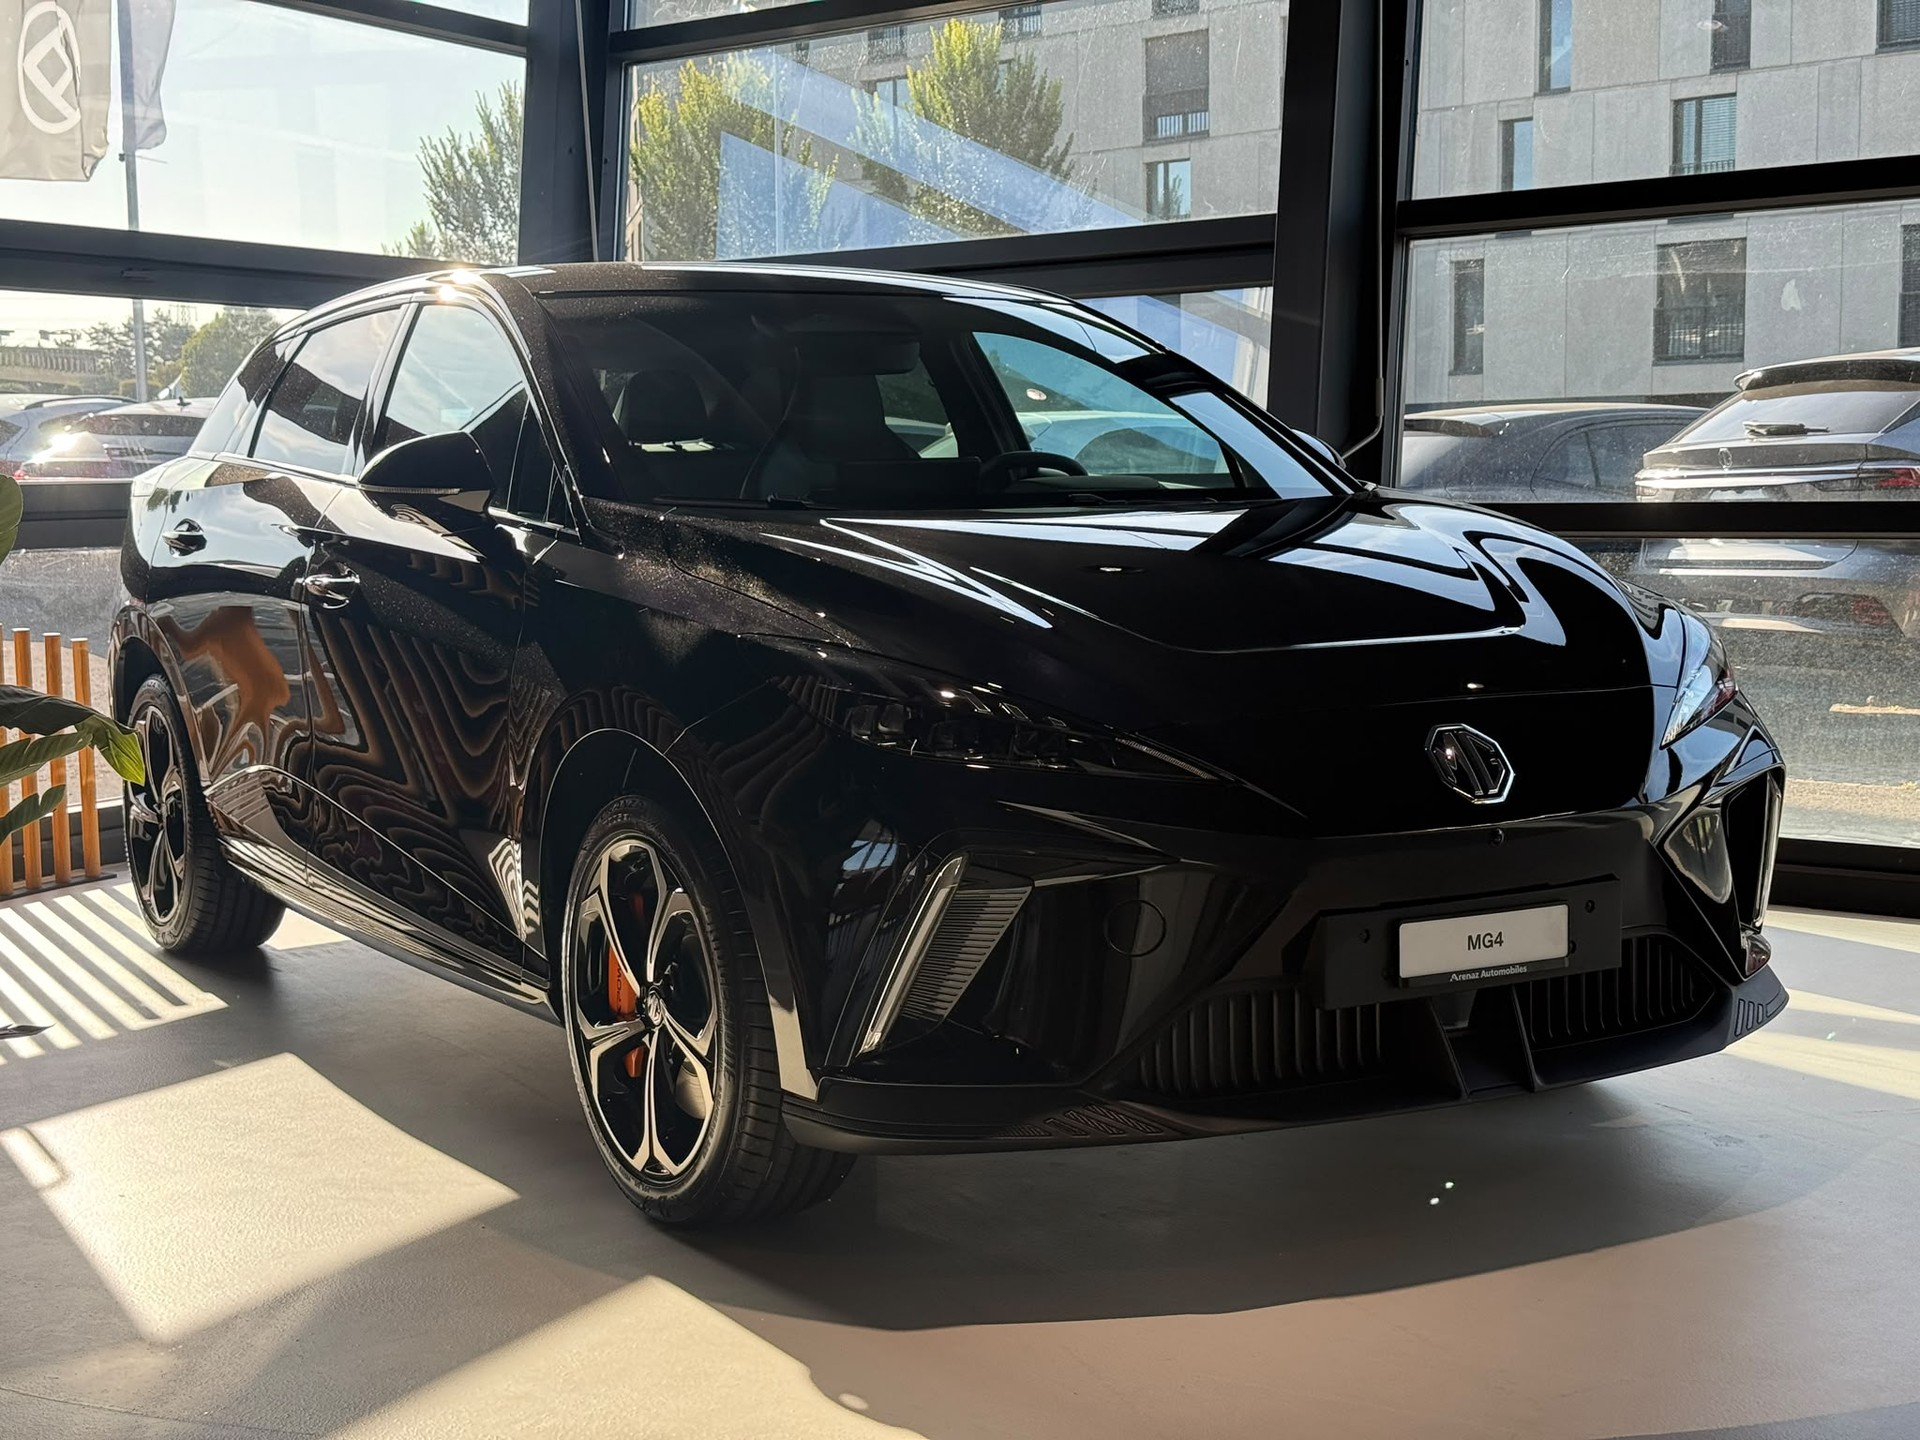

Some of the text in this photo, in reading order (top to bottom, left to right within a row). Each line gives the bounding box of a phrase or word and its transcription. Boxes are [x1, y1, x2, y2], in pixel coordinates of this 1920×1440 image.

[1434, 731, 1506, 795] MG
[1467, 931, 1504, 951] MG4
[1450, 965, 1527, 982] Arenaz Automobiles
